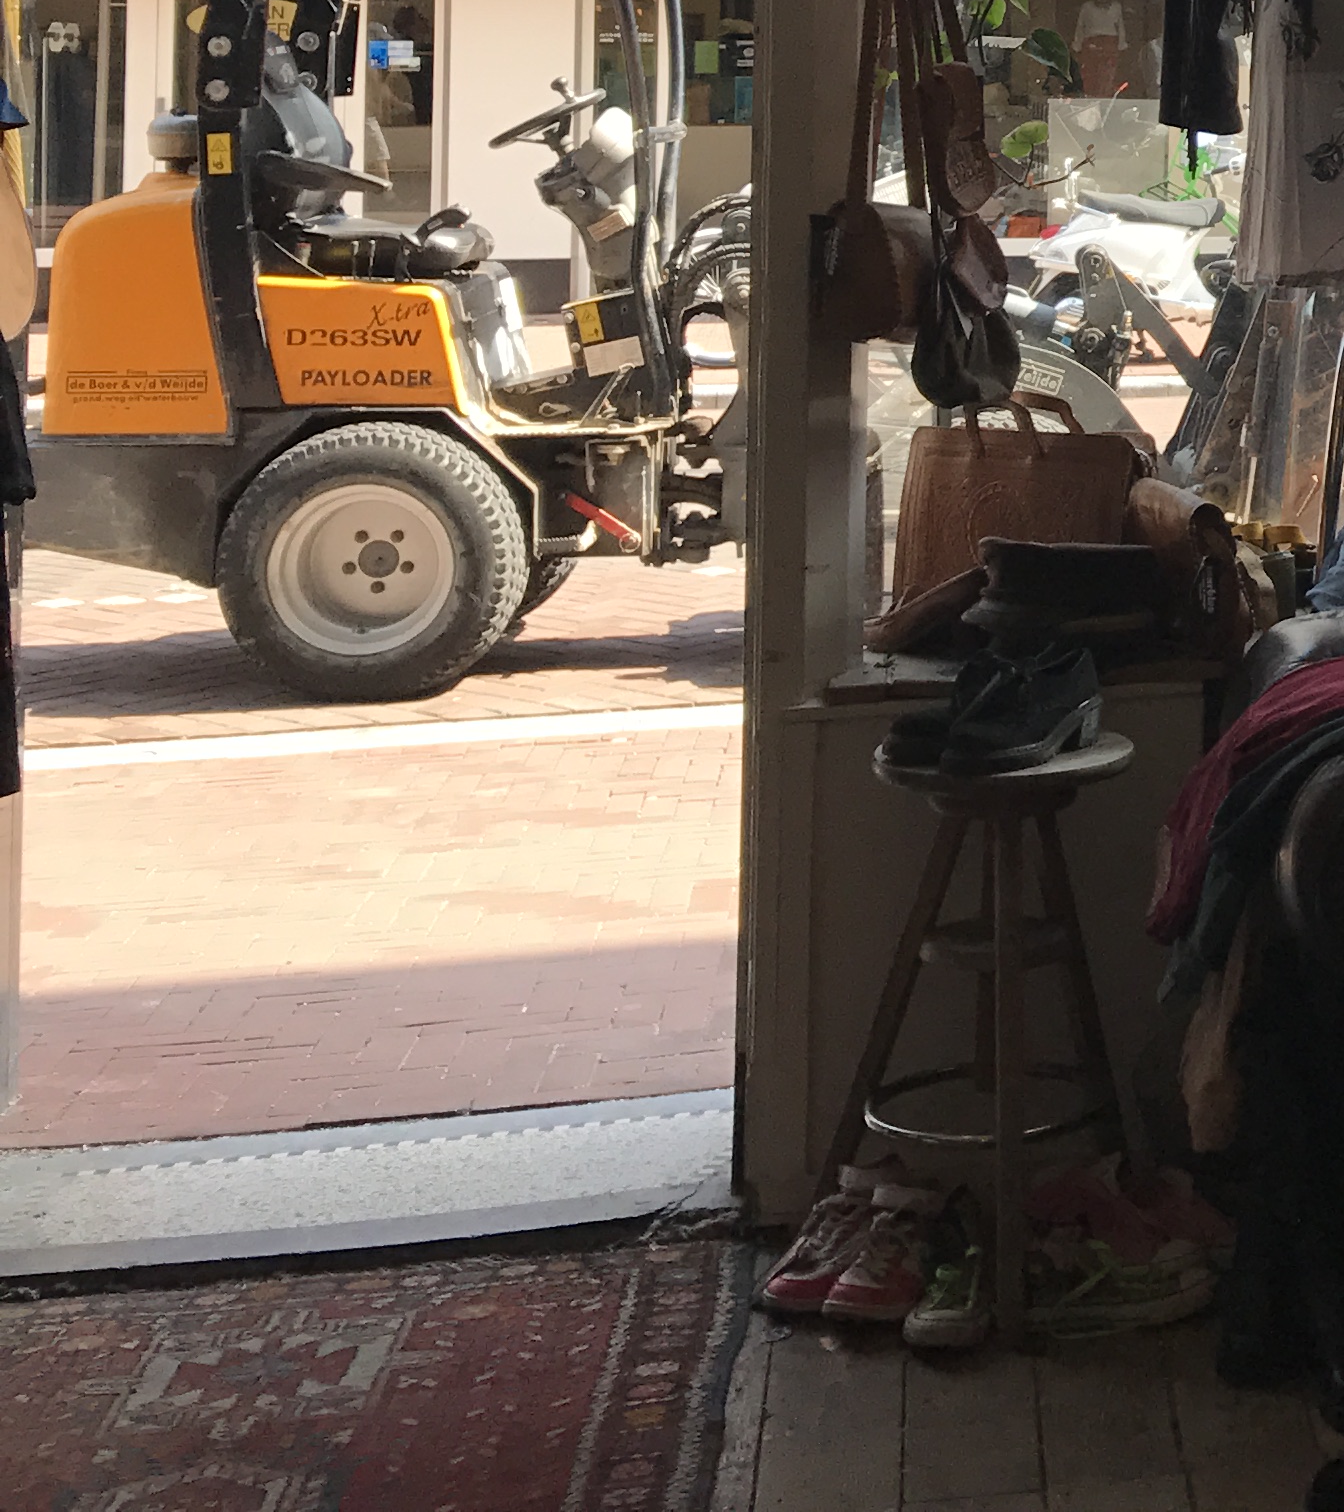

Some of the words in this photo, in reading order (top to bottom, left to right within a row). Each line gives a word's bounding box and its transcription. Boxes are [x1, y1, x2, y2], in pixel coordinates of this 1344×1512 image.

[286, 328, 422, 346] D263SW
[69, 379, 85, 389] de
[89, 379, 118, 389] Boer
[121, 379, 130, 389] &
[160, 378, 204, 391] Weijde
[301, 369, 432, 387] PAYLOADER
